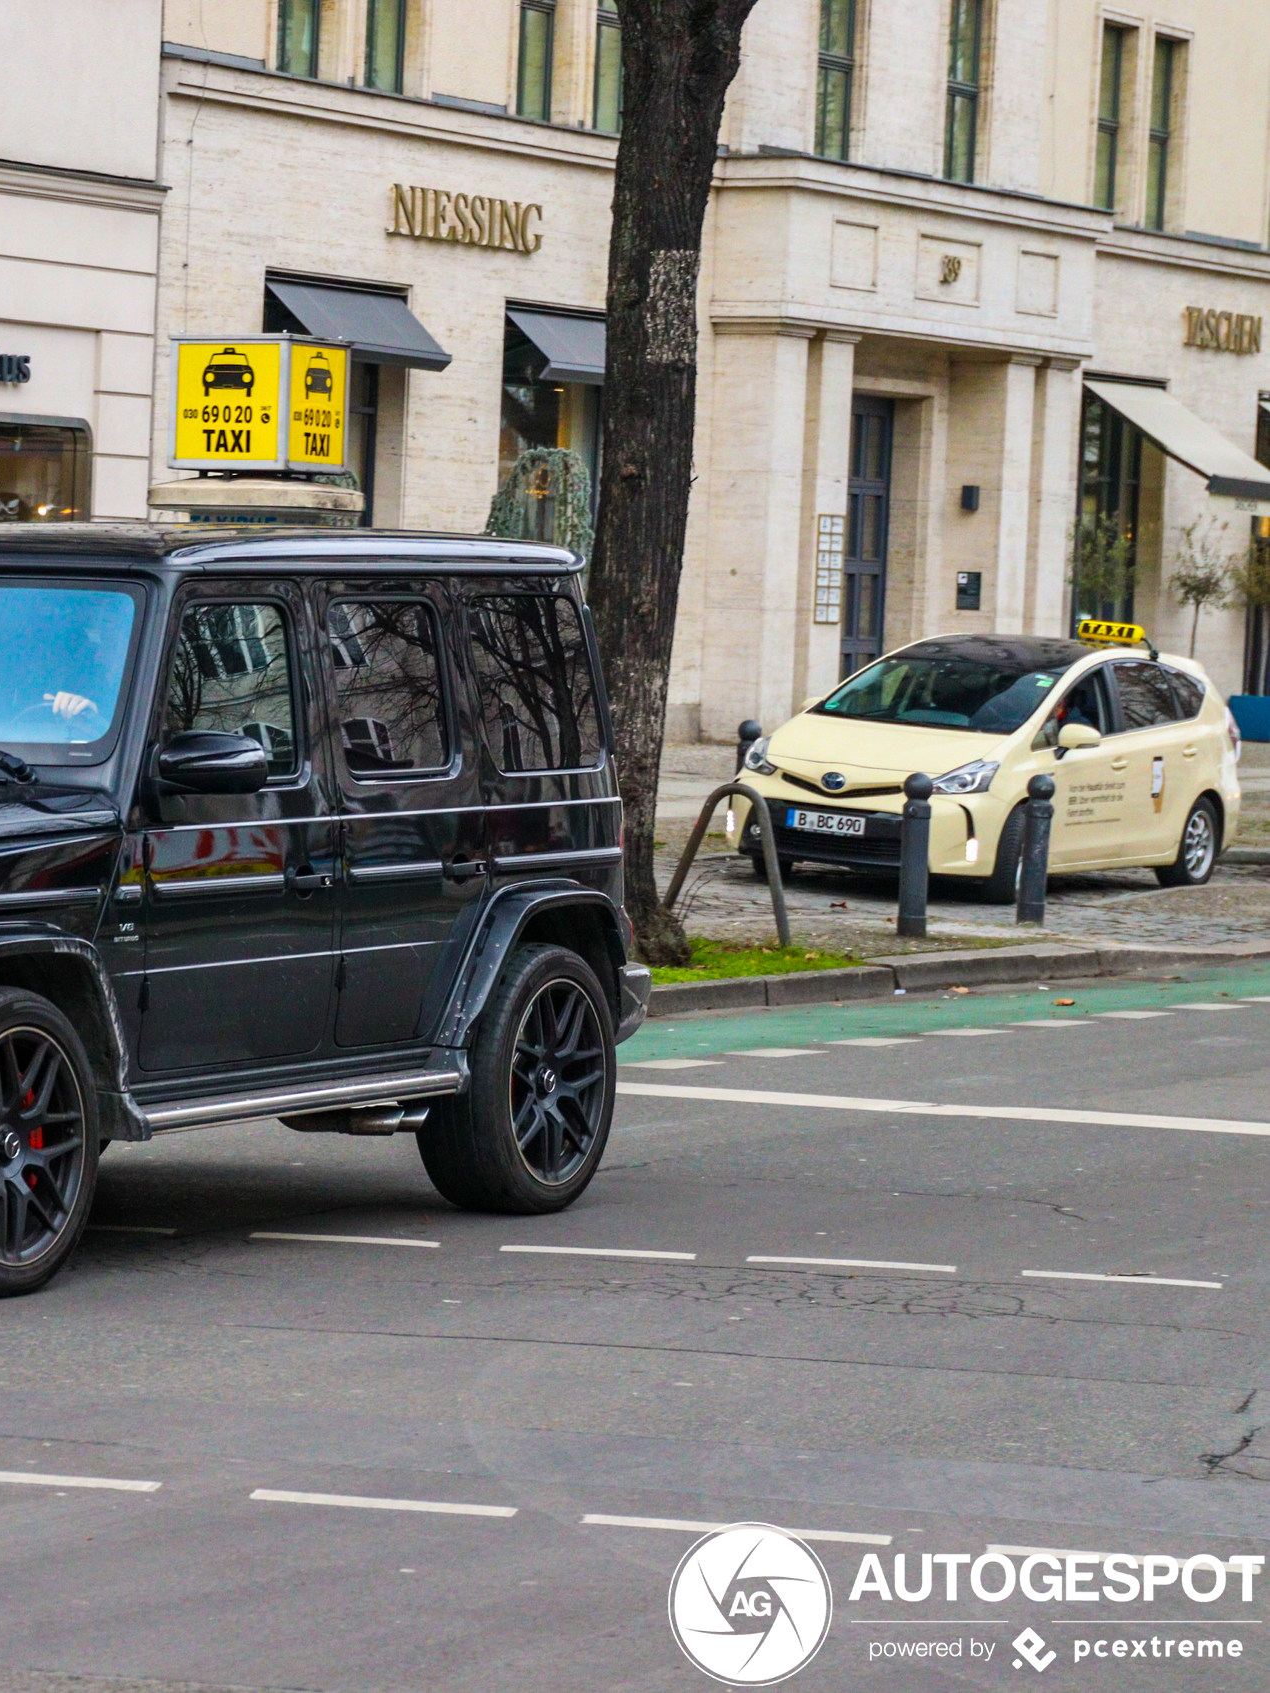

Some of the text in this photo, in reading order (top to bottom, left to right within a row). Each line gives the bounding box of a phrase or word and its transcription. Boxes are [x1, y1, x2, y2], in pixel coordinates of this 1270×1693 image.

[385, 183, 544, 253] NIESSING
[1184, 306, 1262, 354] TASCHEN
[183, 408, 199, 419] 030
[202, 429, 251, 453] TAXI
[304, 432, 330, 457] TAXI
[1088, 623, 1130, 637] TAXI
[798, 812, 861, 833] B BC 690
